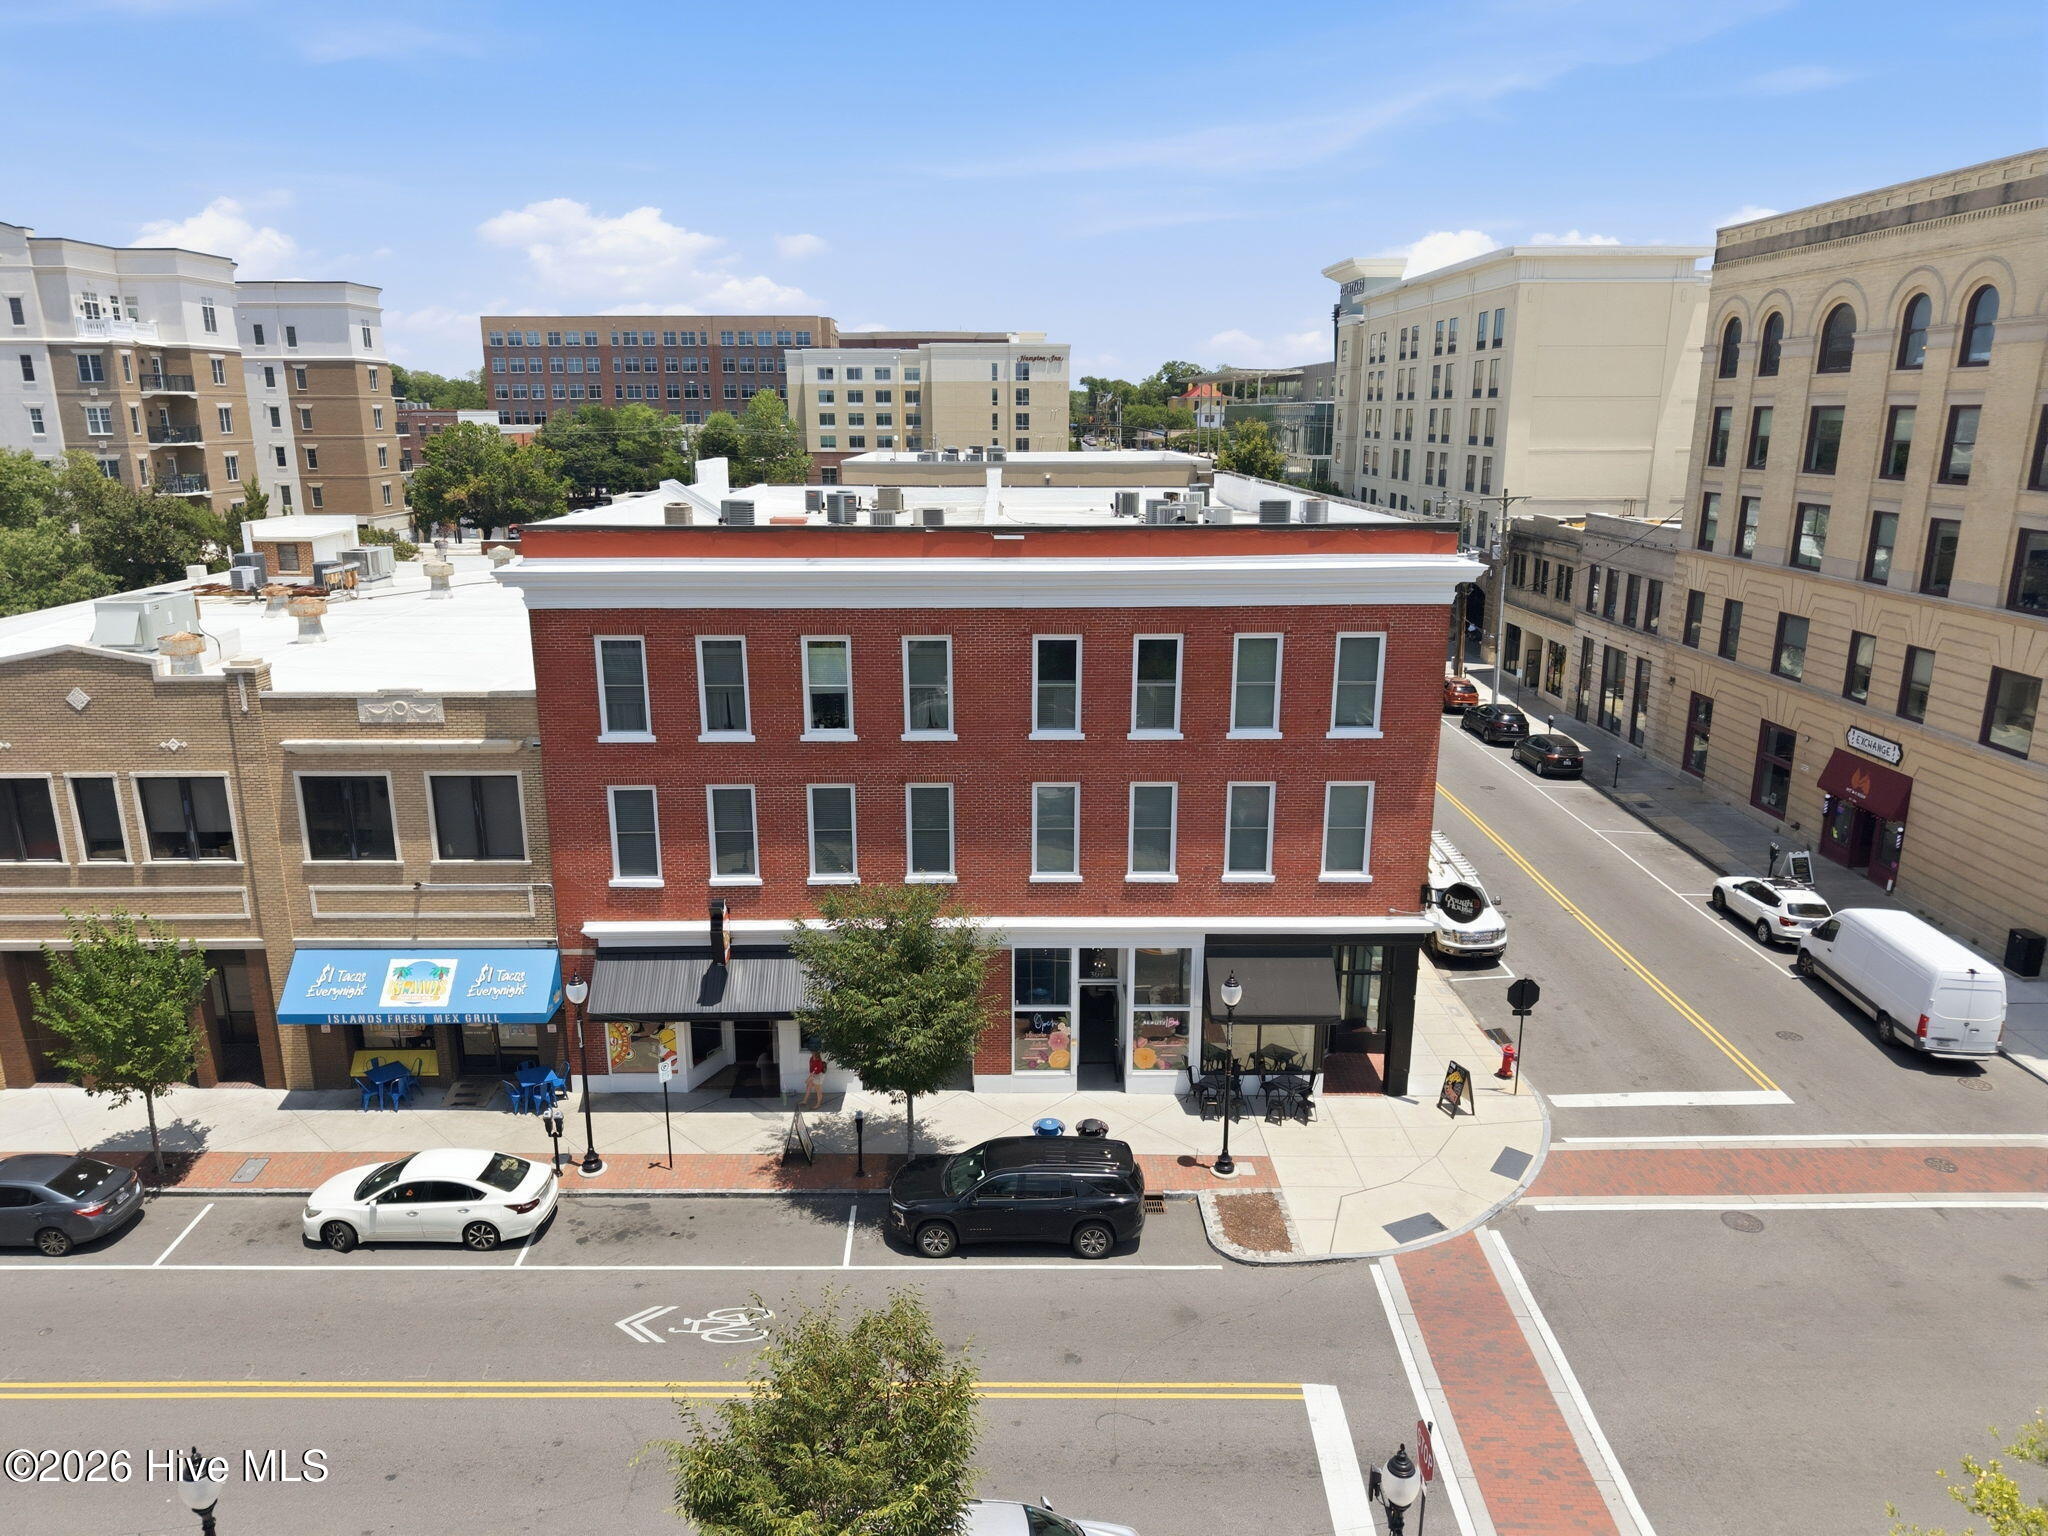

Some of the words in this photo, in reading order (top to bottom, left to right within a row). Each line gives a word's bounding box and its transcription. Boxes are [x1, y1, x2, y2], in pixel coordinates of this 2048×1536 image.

[1017, 354, 1047, 362] Hampton
[1049, 354, 1064, 363] Inn
[1856, 735, 1891, 757] EXCHANGE
[1445, 893, 1474, 908] Dough
[1447, 900, 1474, 914] House
[316, 963, 335, 987] $1
[338, 970, 367, 983] Tacos
[475, 963, 494, 987] $1
[496, 969, 526, 982] Tacos
[305, 983, 368, 1001] Everynight
[466, 982, 528, 1000] Everynight
[327, 1014, 382, 1024] ISLANDS
[387, 1014, 426, 1024] FRESH
[433, 1014, 460, 1024] MEX
[464, 1013, 501, 1024] GRILL
[1033, 1012, 1058, 1031] Open
[1417, 1427, 1433, 1470] STOP
